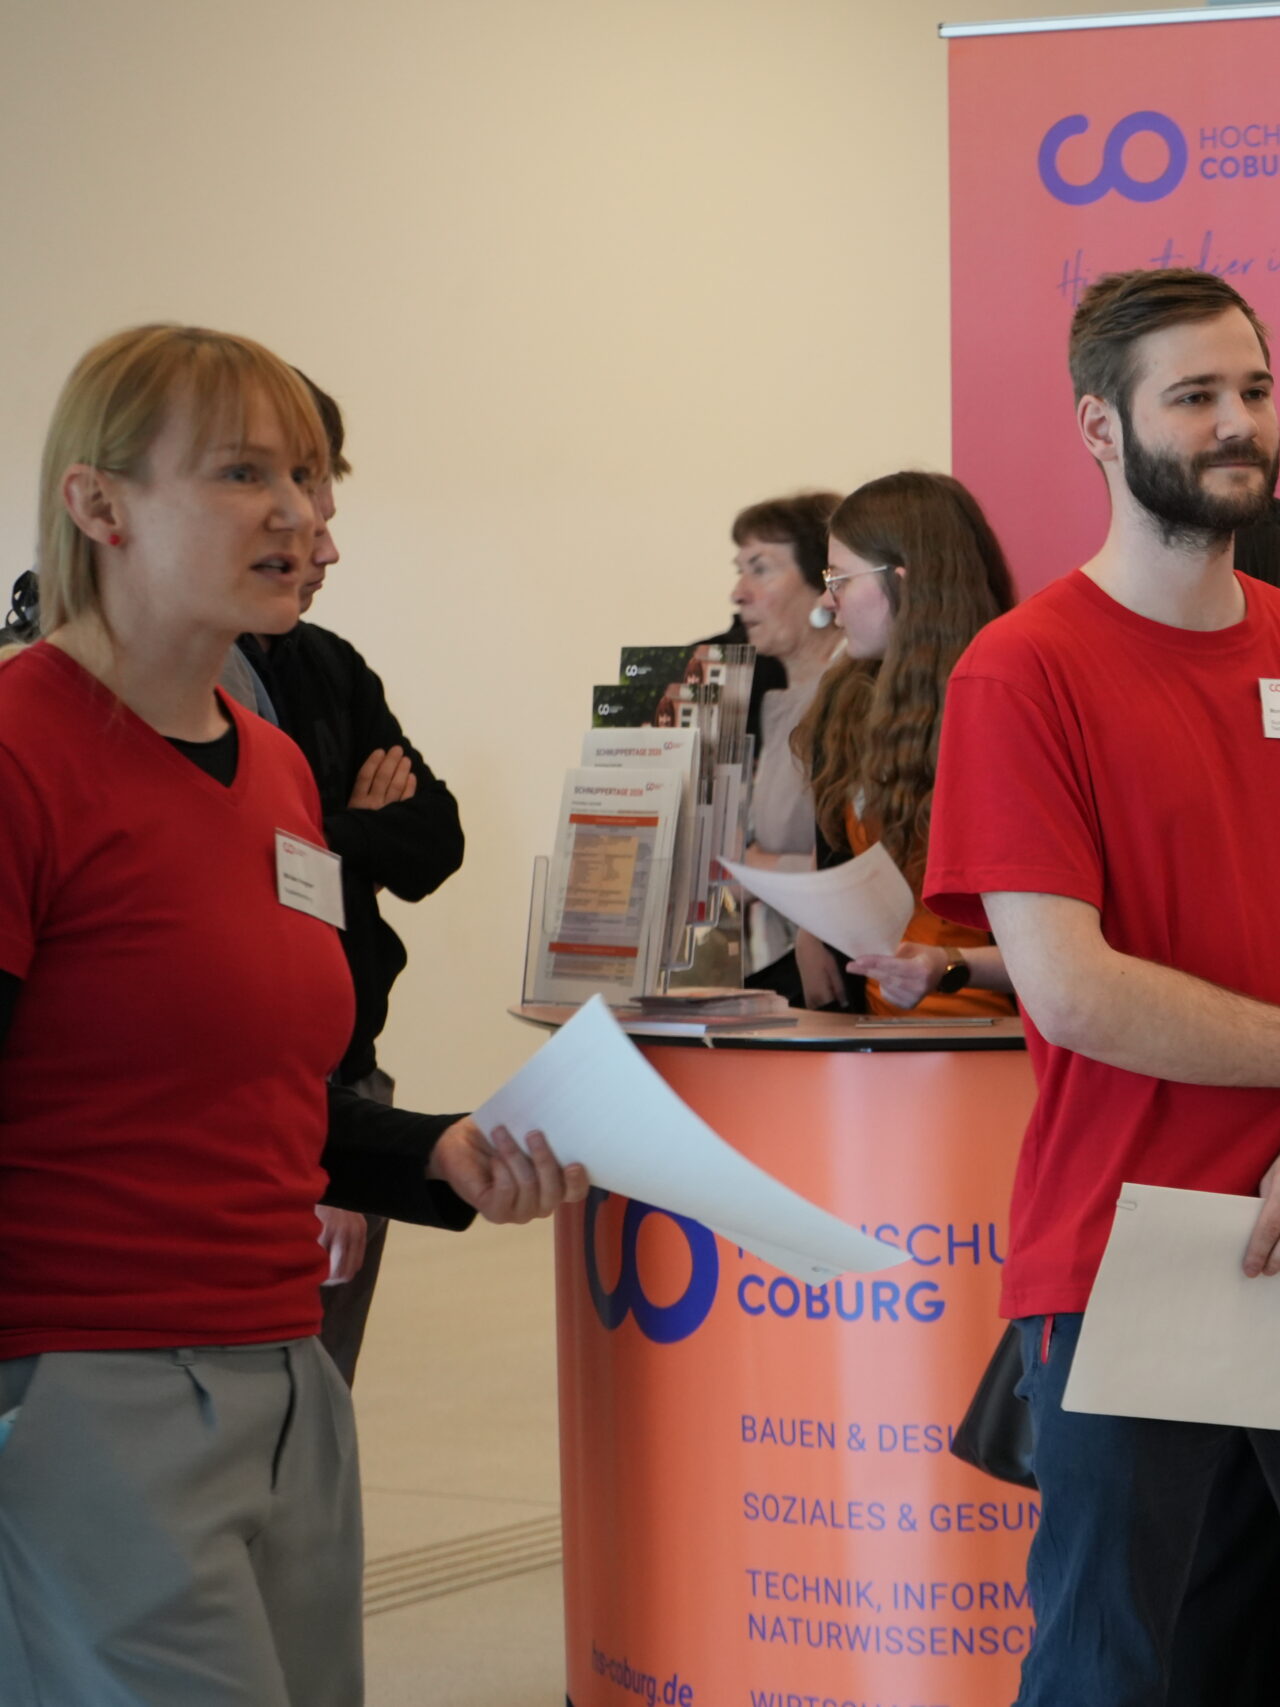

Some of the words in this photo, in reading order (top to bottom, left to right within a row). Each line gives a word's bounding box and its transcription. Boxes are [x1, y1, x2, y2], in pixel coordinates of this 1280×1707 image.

[737, 1274, 945, 1323] COBURG
[741, 1415, 836, 1449] BAUEN
[846, 1423, 867, 1451] &
[878, 1424, 954, 1453] DESI
[743, 1492, 887, 1531] SOZIALES
[897, 1502, 917, 1532] &
[929, 1502, 1041, 1532] GESUN
[746, 1569, 882, 1613] TECHNIK,
[893, 1581, 1033, 1611] INFORM
[748, 1613, 1036, 1656] NATURWISSENSC
